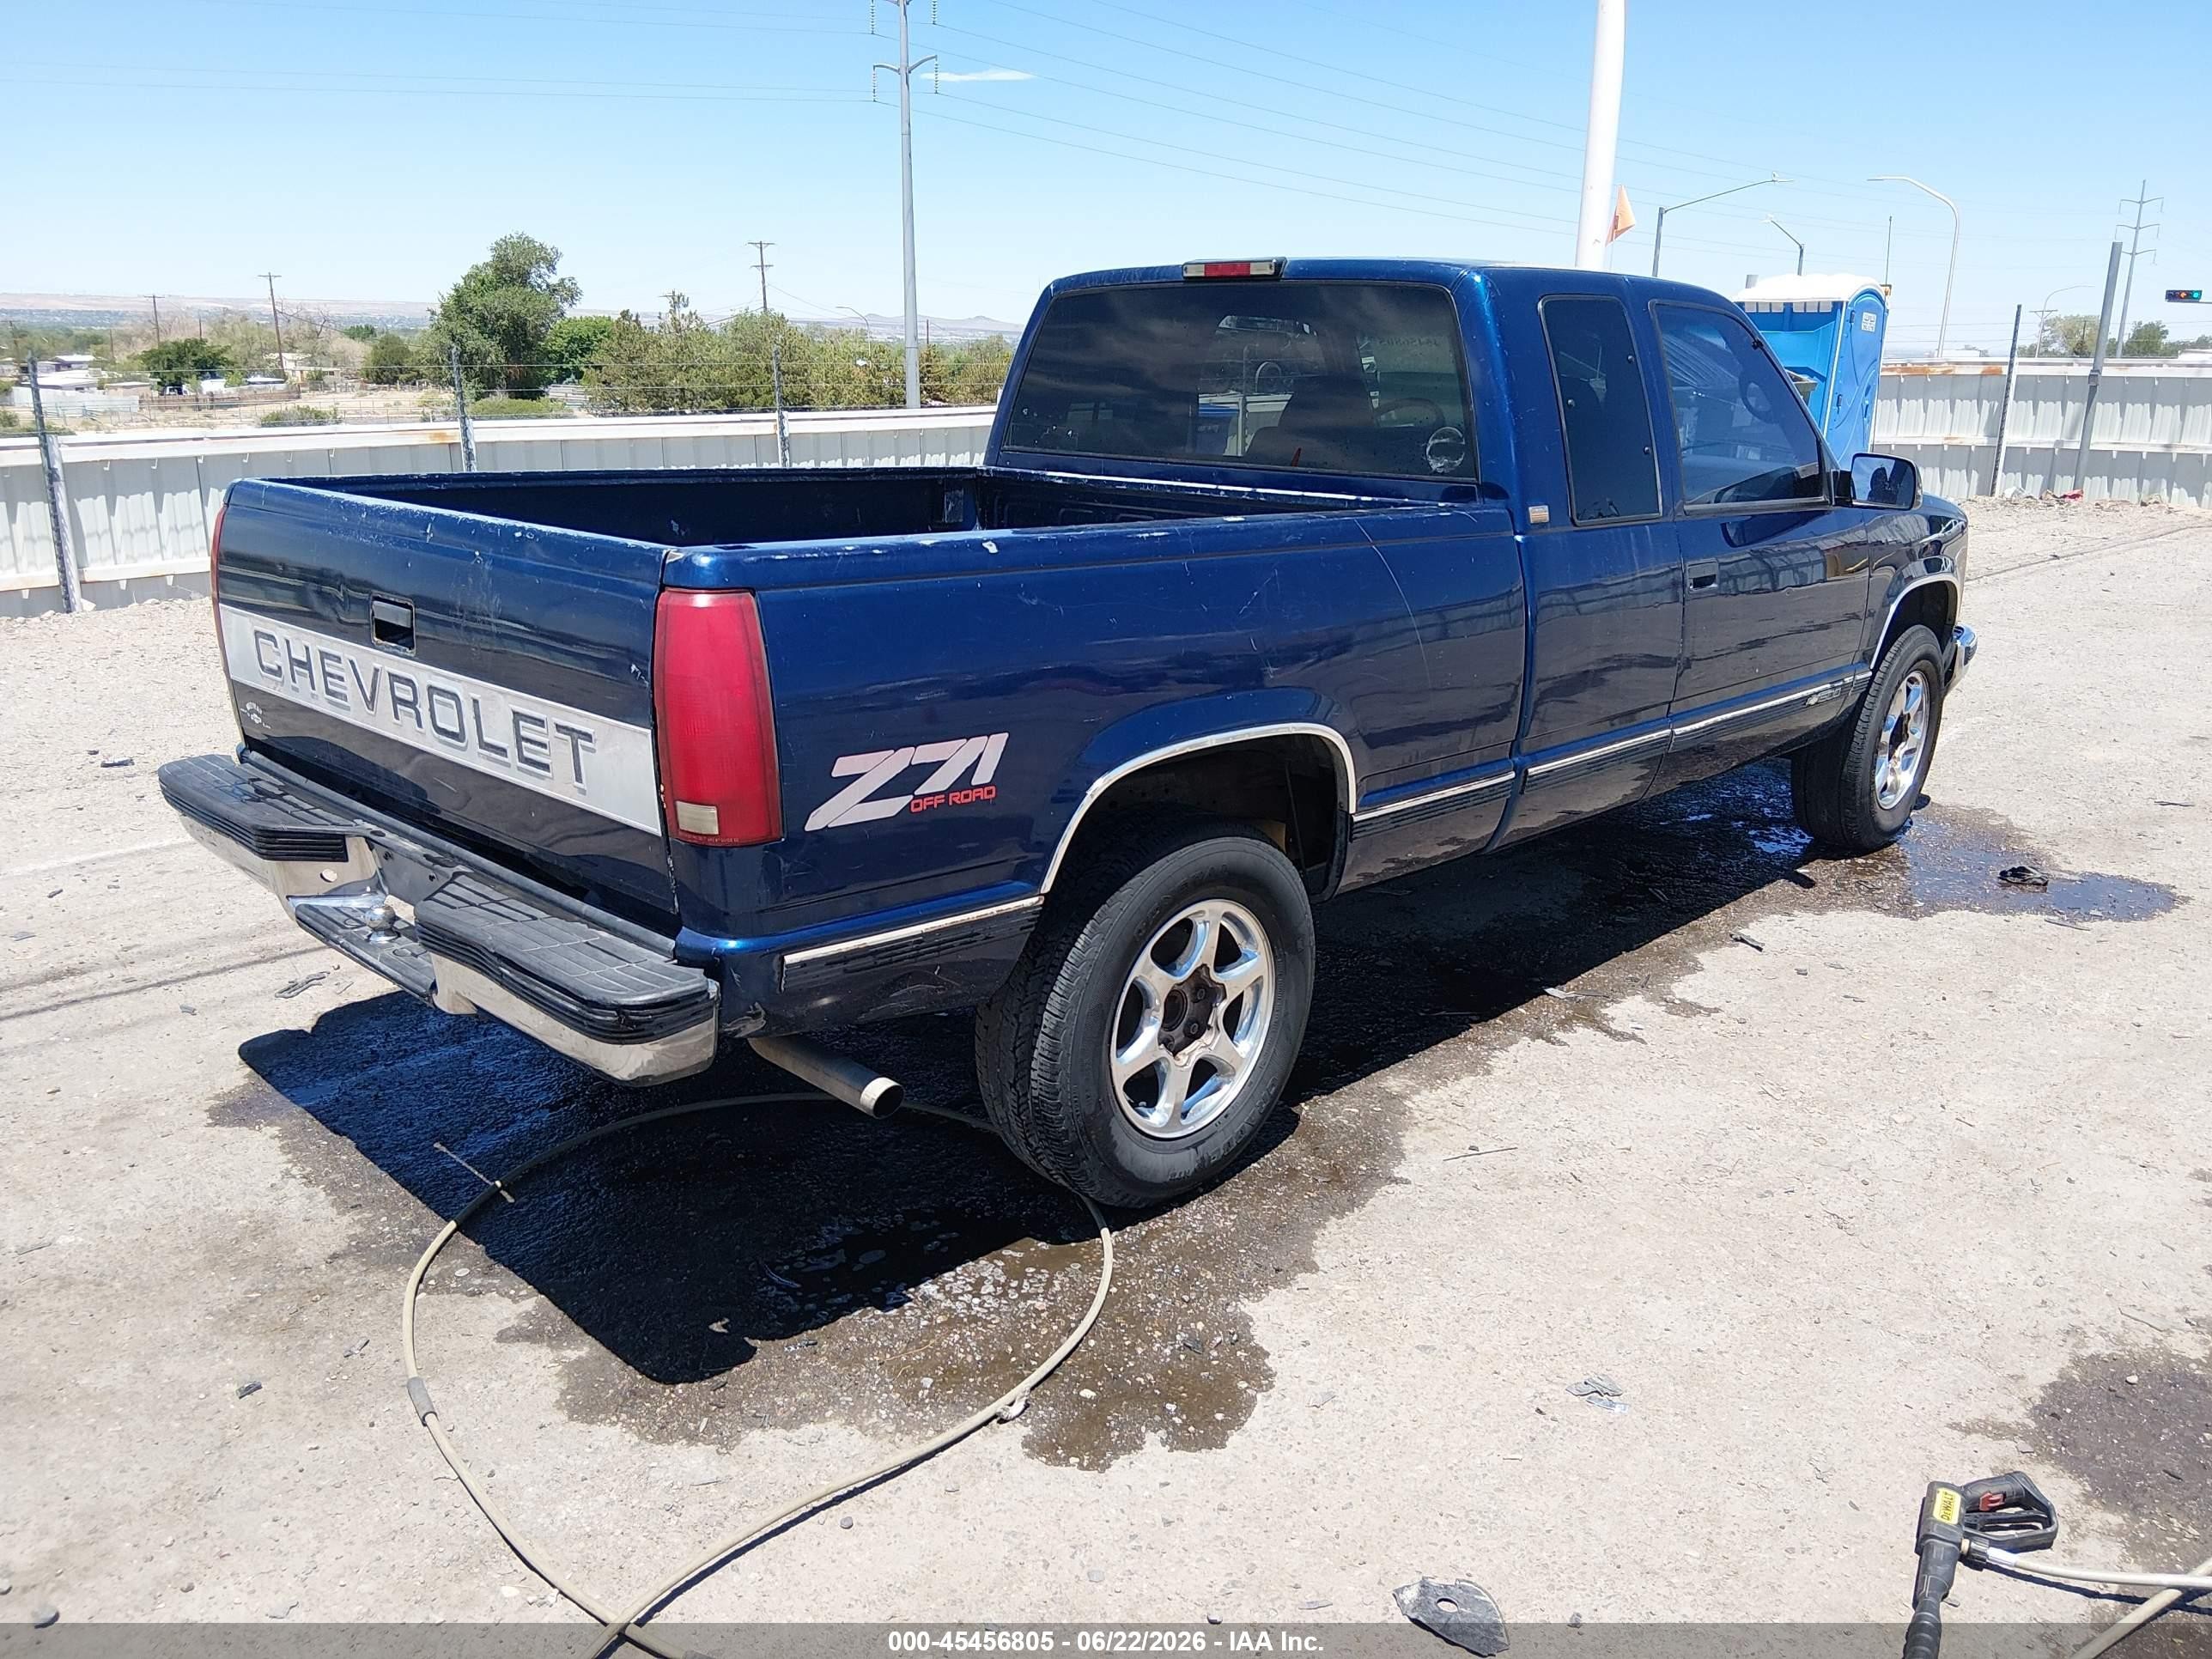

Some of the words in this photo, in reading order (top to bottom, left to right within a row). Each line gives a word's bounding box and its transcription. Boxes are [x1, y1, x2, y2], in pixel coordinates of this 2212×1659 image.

[254, 629, 595, 787] CHEVROLET
[805, 732, 1009, 831] Z71
[910, 794, 945, 812] OFF
[949, 786, 996, 805] ROAD
